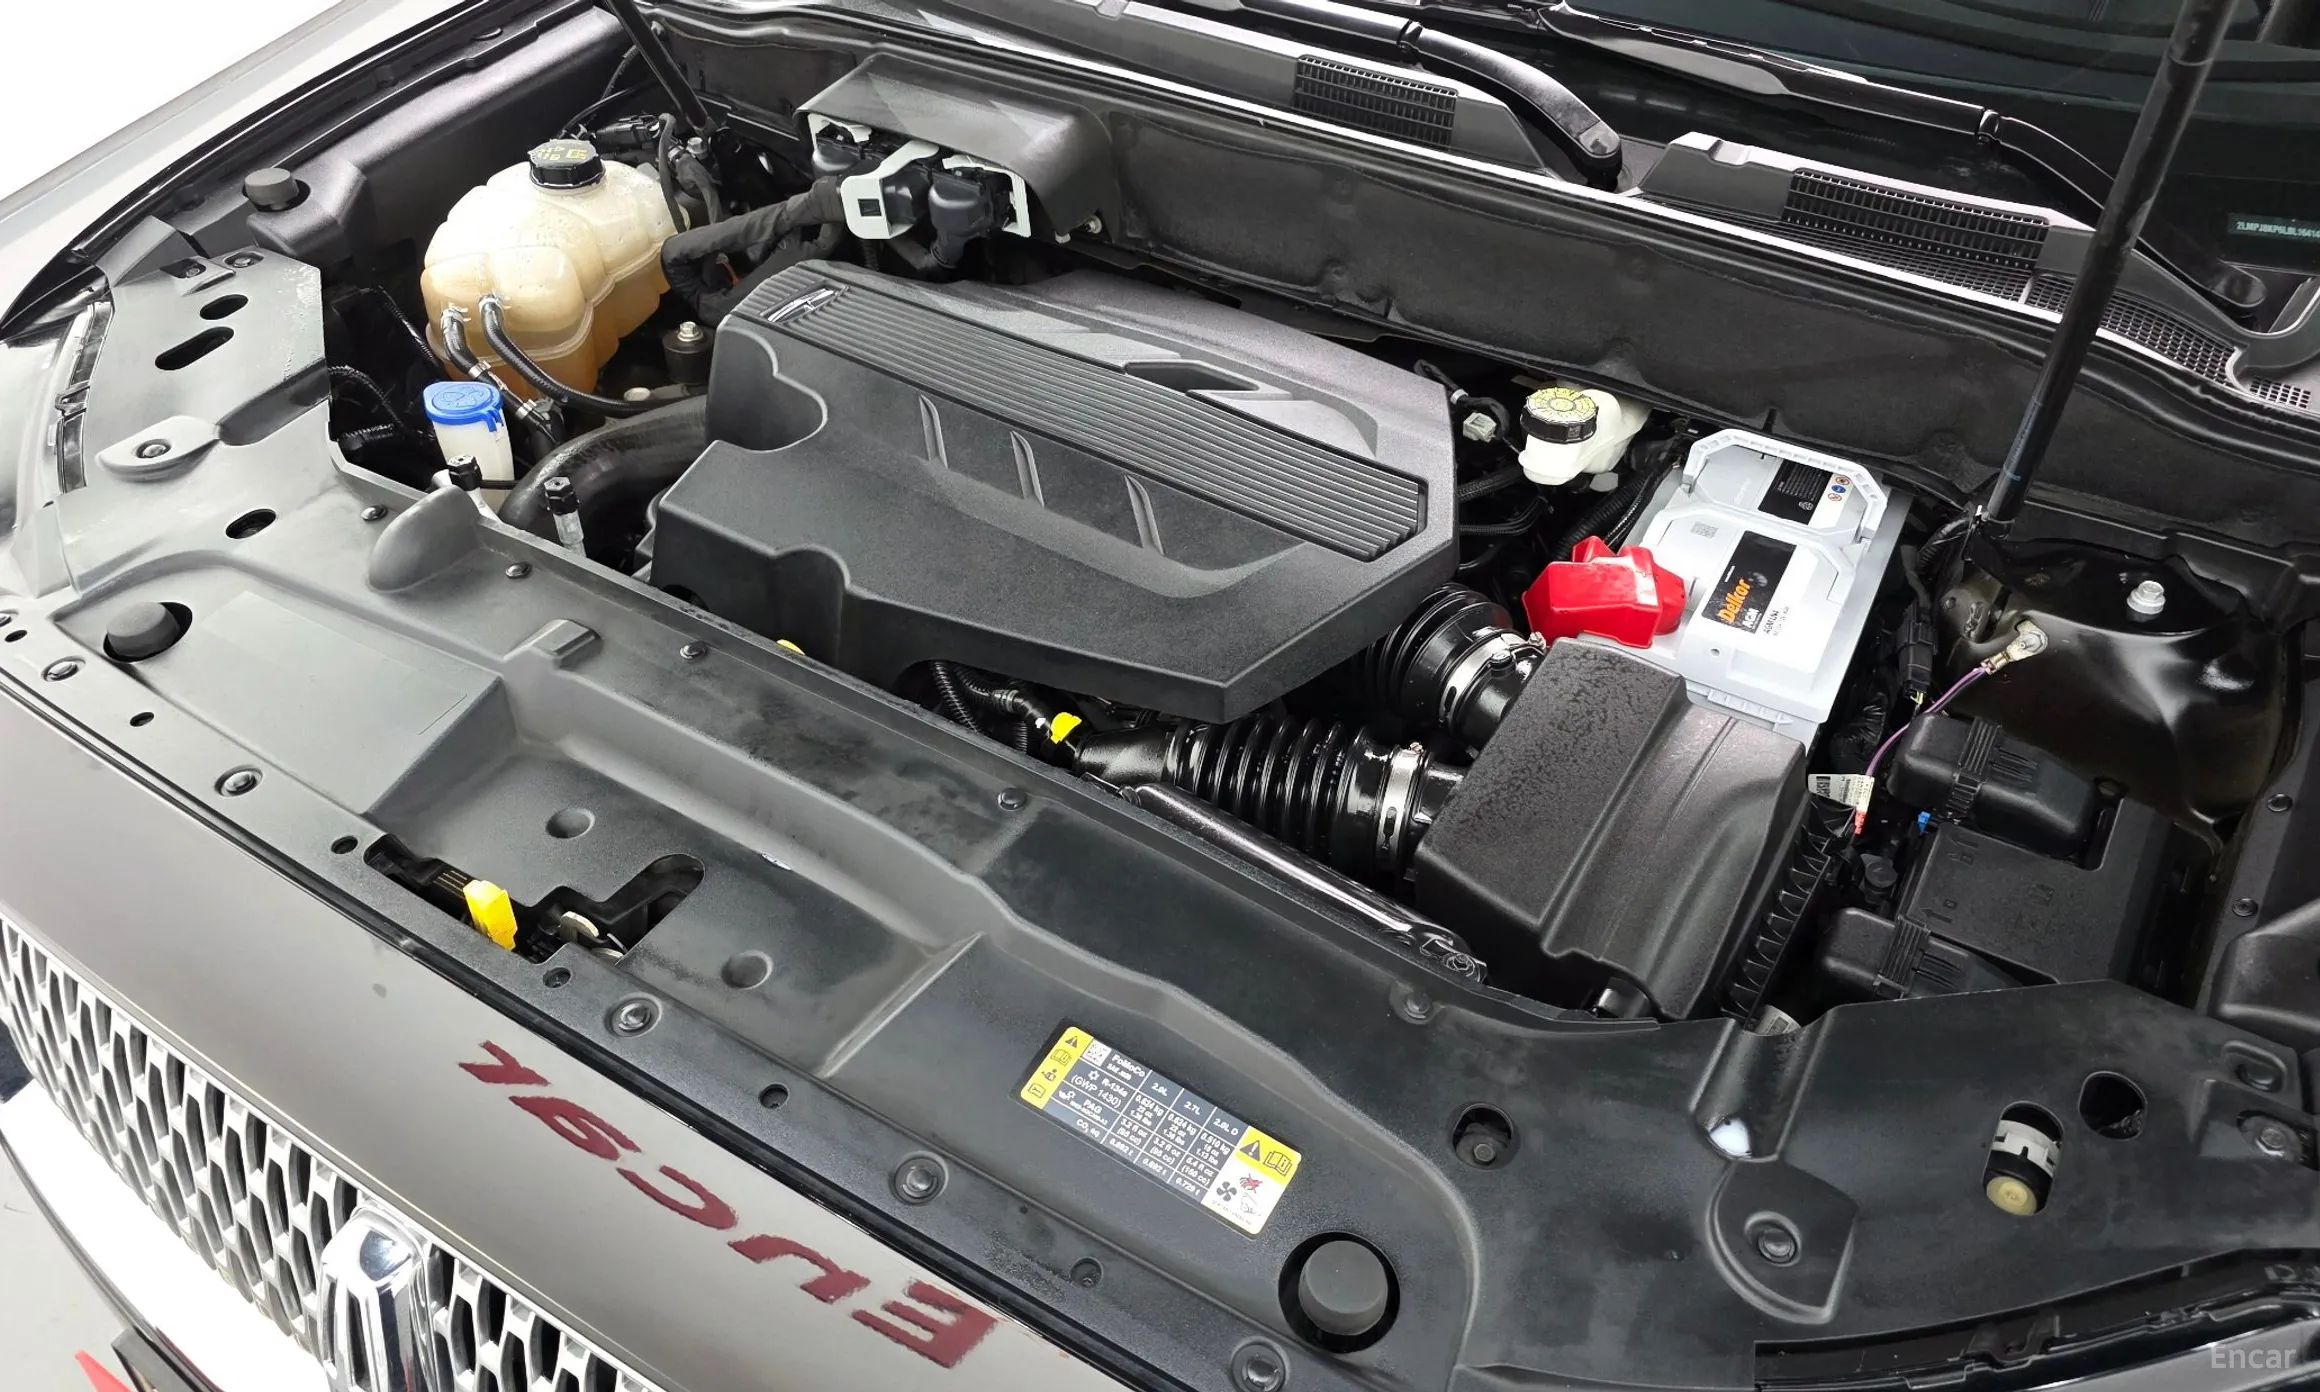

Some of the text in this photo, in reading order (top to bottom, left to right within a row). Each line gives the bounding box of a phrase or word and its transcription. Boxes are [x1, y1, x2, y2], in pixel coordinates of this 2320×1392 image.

[1718, 579, 1750, 623] Delkor
[1742, 608, 1760, 628] AGM
[1112, 1054, 1146, 1077] FoMoCo
[1071, 1074, 1122, 1108] (GWP 1430)
[1102, 1078, 1128, 1097] R-134a
[1152, 1083, 1168, 1096] 2.0L
[1083, 1099, 1102, 1114] PAG
[1154, 1105, 1164, 1117] kg
[1184, 1101, 1200, 1115] 2.7L
[1120, 1119, 1131, 1129] 3.2
[1137, 1130, 1148, 1138] oz
[1187, 1123, 1197, 1136] kg
[1213, 1118, 1229, 1132] 2.0L
[1153, 1138, 1164, 1148] 3.2
[1171, 1149, 1181, 1157] oz
[1220, 1142, 1231, 1155] kg
[1162, 1154, 1175, 1165] cc)
[1204, 1168, 1214, 1177] oz
[1176, 1178, 1195, 1192] 0.729
[1197, 1174, 1210, 1186] cc)
